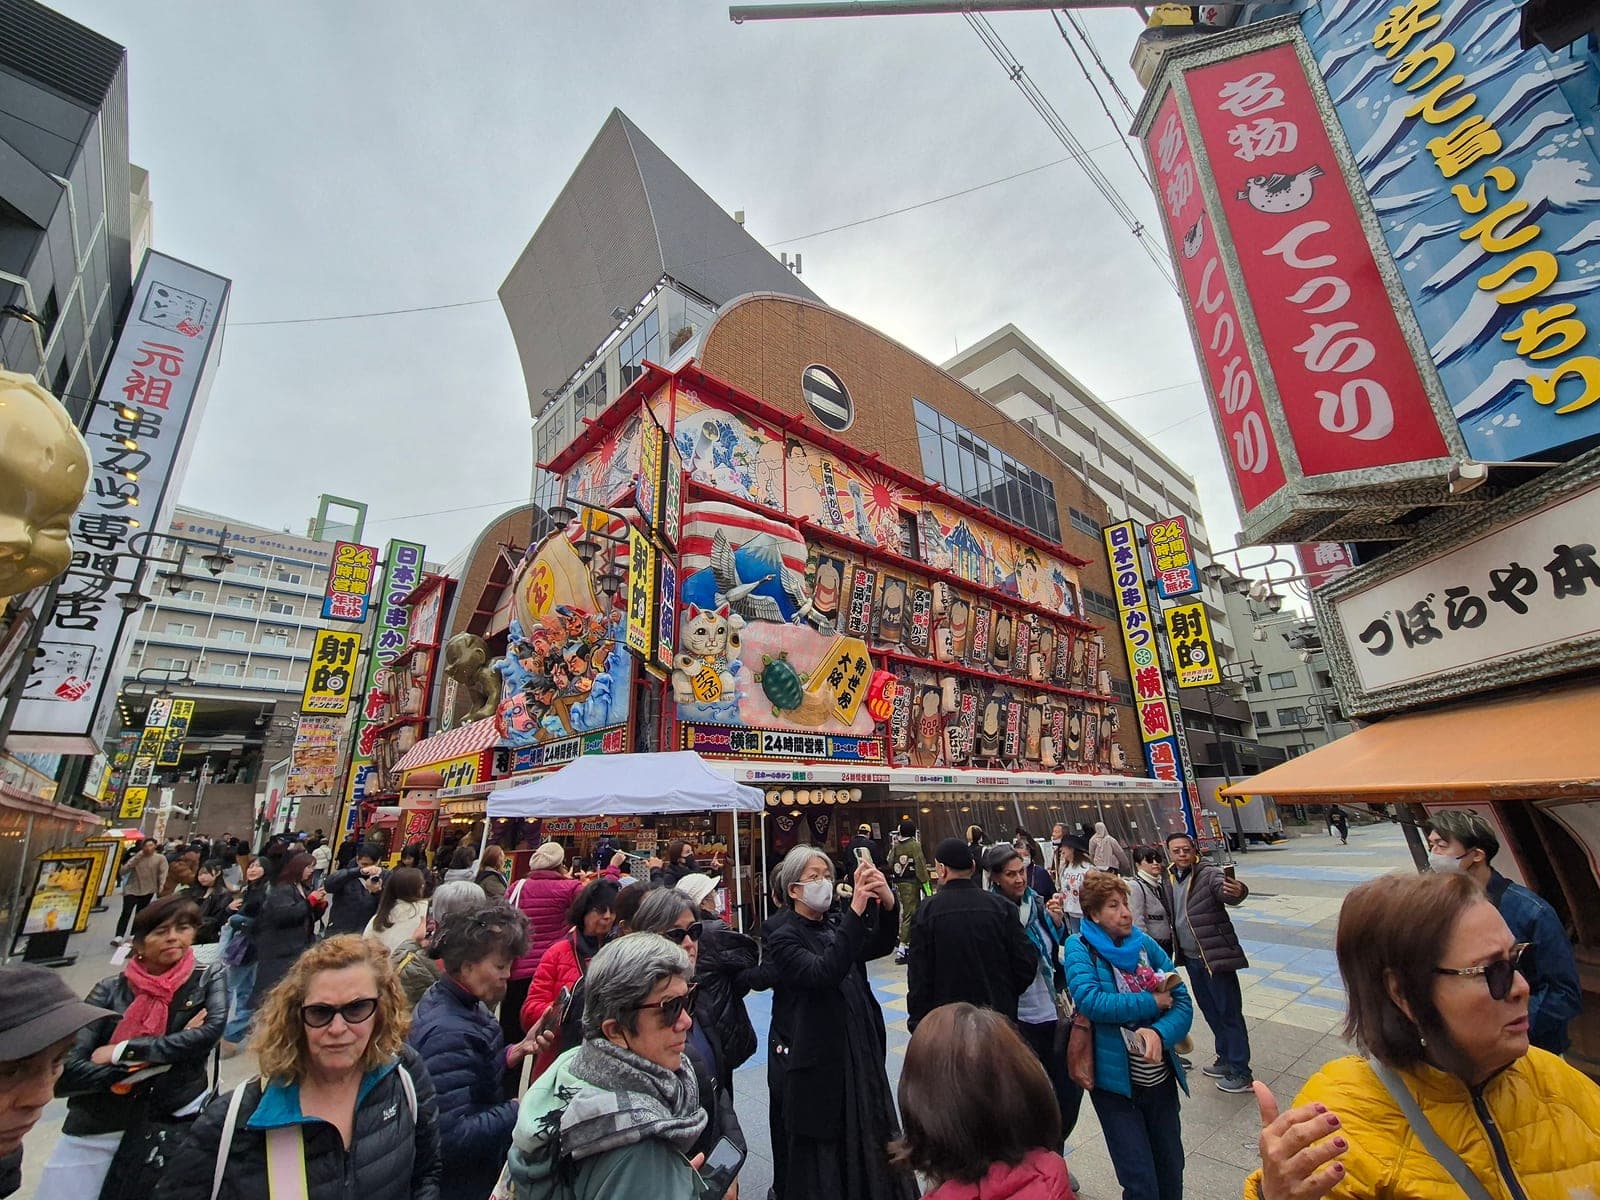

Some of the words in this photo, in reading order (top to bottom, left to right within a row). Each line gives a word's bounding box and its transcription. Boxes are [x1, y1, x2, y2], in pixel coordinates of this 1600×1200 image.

[1218, 72, 1299, 162] 名物
[1157, 113, 1195, 217] 名物
[1151, 521, 1183, 543] 24
[337, 545, 373, 566] 24
[1154, 539, 1186, 557] 時間
[335, 564, 371, 581] 時間
[1156, 553, 1190, 571] 営業
[332, 578, 368, 595] 営業
[1110, 526, 1150, 647] 日本一の串かつ
[1162, 569, 1189, 583] 年中
[1164, 580, 1192, 595] 無休
[331, 604, 362, 618] 無休
[332, 594, 363, 608] 年中
[376, 545, 419, 667] 日本一の串かつ
[849, 569, 866, 633] 逸品料理
[1171, 608, 1210, 669] 射的
[312, 634, 356, 696] 射的
[828, 651, 852, 689] 大阪
[837, 656, 867, 710] 新世界
[1135, 666, 1171, 736] 横綱
[544, 740, 579, 763] 24時間営業
[730, 730, 759, 752] 横綱
[764, 734, 825, 755] 24時間営業
[857, 740, 879, 758] 横綱
